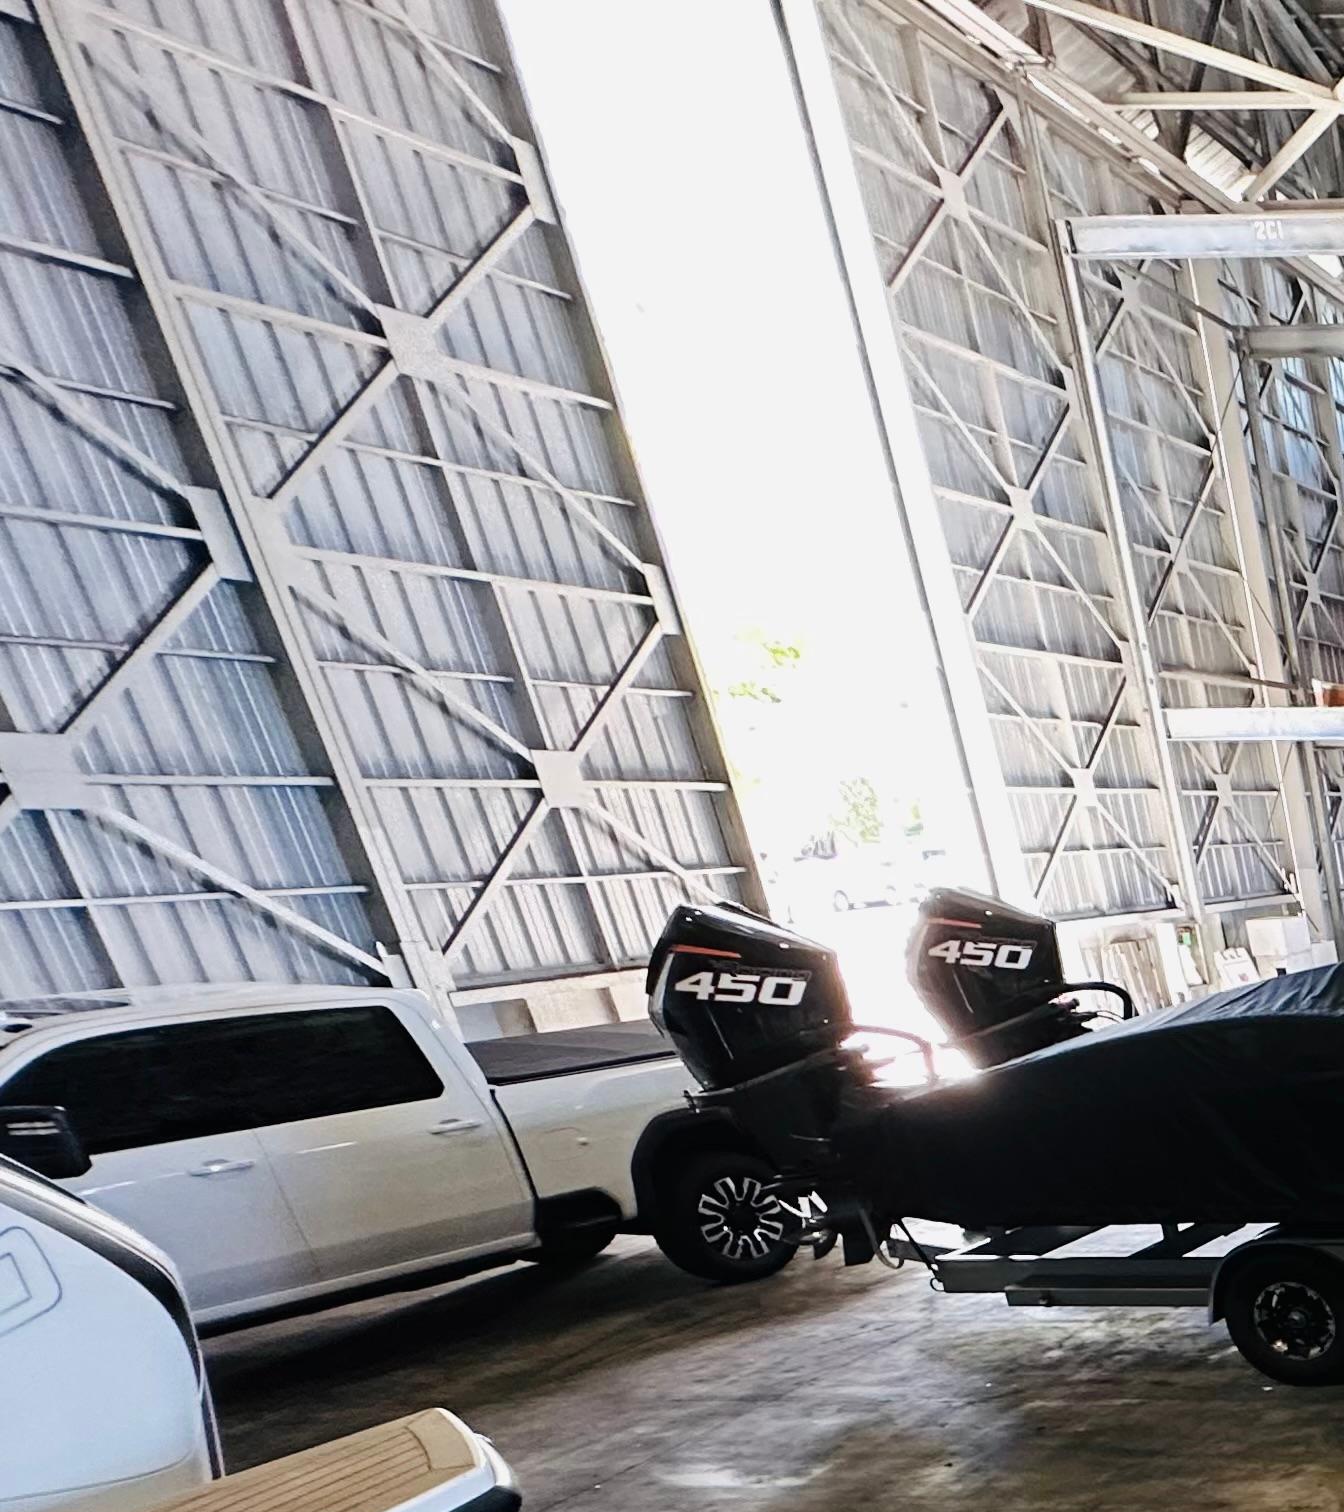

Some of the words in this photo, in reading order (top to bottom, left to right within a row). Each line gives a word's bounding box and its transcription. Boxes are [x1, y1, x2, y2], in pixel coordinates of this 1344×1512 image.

[1254, 220, 1284, 240] 2C1
[928, 939, 1034, 970] 450
[674, 971, 808, 1006] 450
